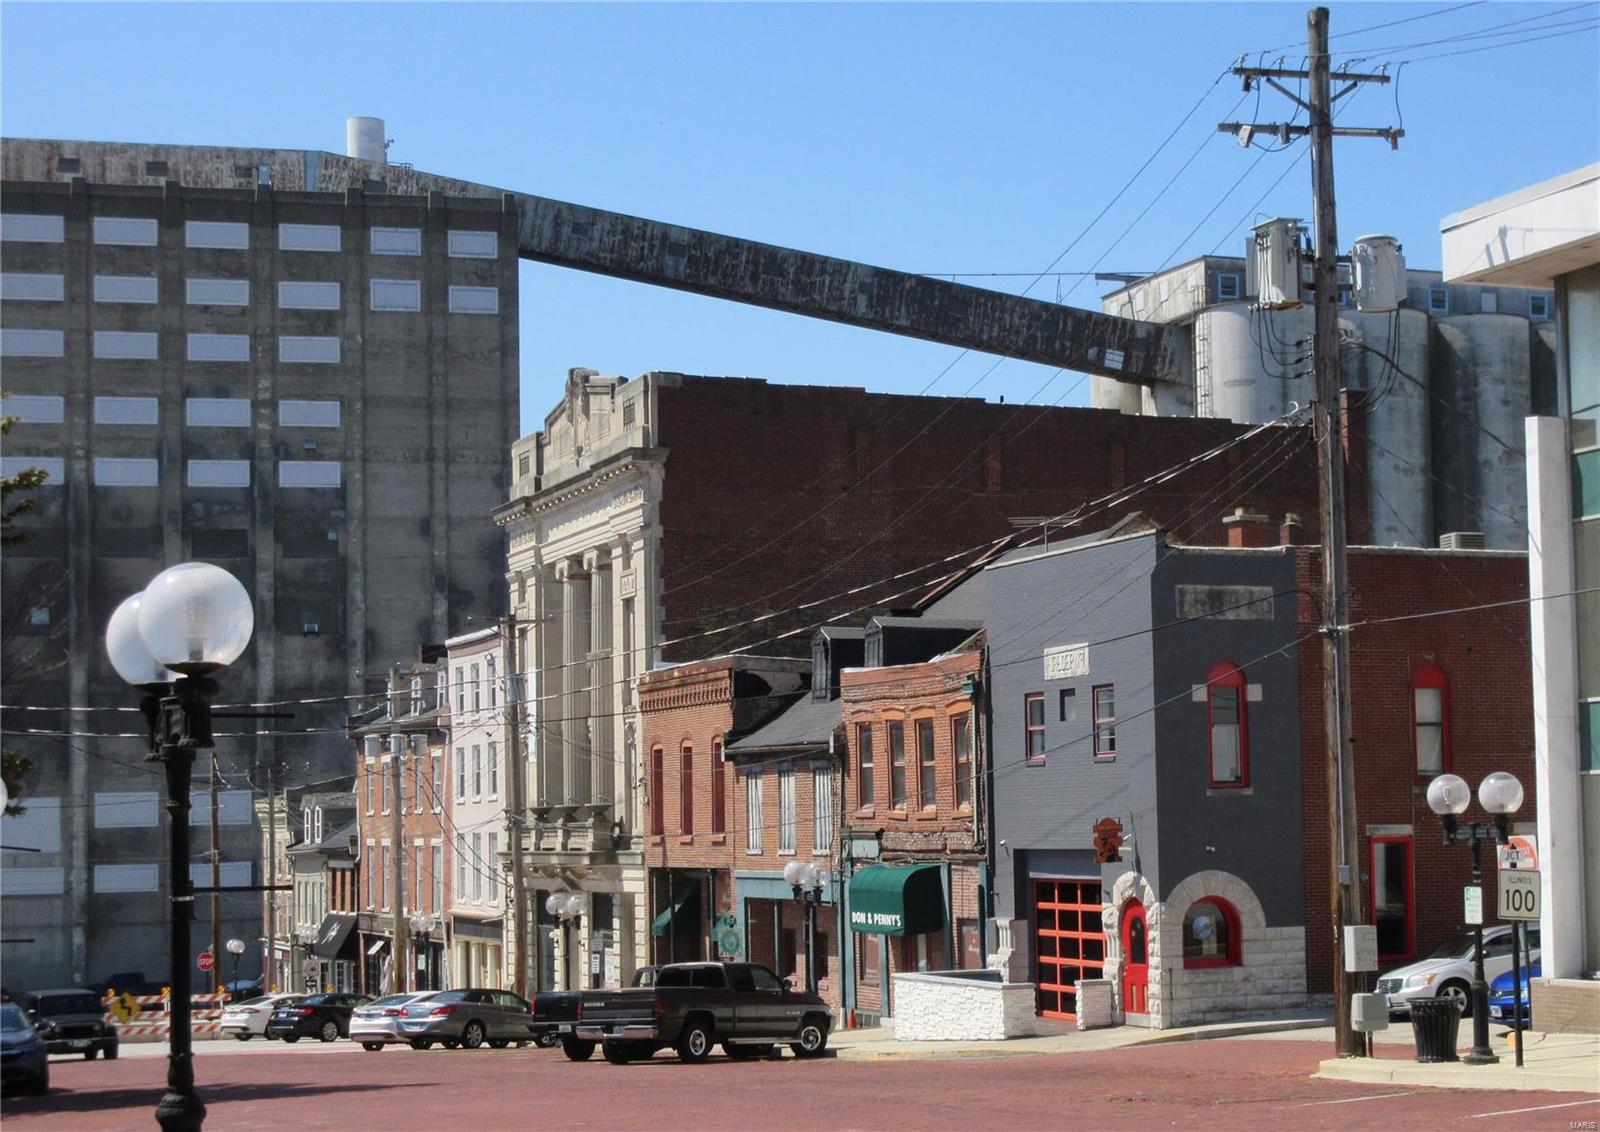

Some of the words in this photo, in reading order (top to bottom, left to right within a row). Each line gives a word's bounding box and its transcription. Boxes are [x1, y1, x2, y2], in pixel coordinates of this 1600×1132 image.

[1504, 850, 1520, 861] JCT
[1505, 889, 1535, 912] 100
[852, 911, 866, 924] DON
[867, 912, 873, 925] &
[873, 913, 901, 927] PENNY'S
